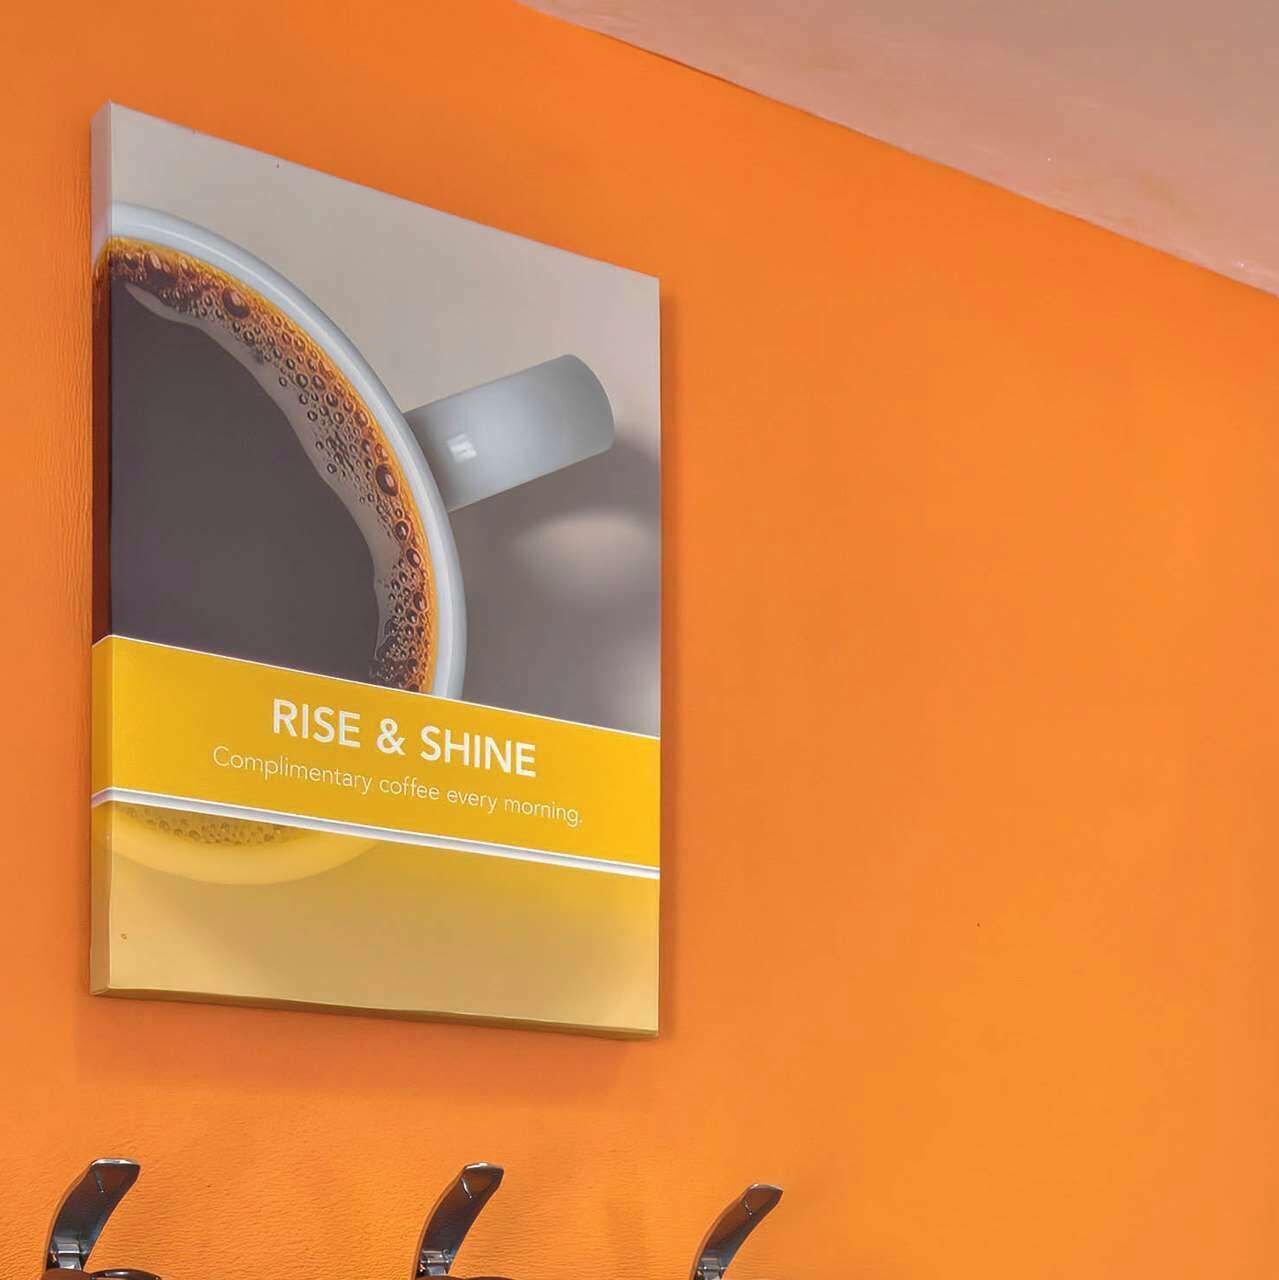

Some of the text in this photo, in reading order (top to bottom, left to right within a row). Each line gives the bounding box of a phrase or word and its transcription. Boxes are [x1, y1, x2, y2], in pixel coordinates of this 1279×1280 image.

[272, 697, 536, 778] RISE & SHINE
[212, 745, 583, 828] Complimentary coffee every morning.
